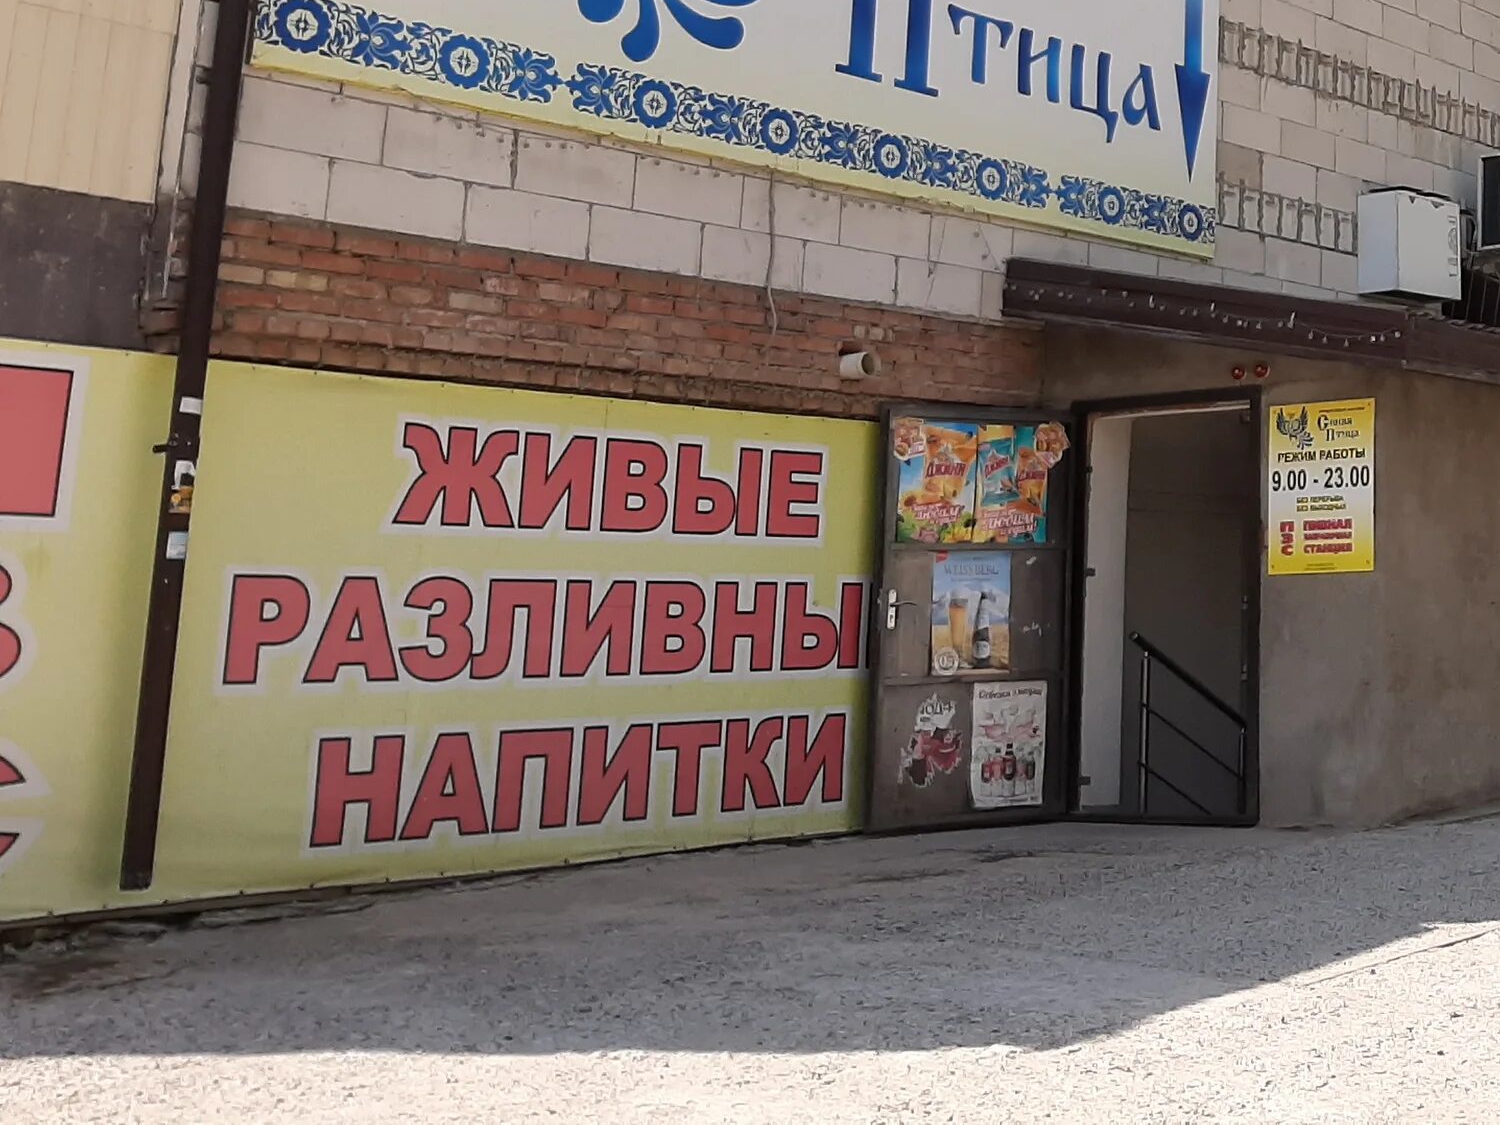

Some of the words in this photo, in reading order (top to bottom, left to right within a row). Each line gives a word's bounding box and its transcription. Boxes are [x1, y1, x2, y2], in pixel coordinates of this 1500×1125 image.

[392, 421, 825, 539] ЖИВЫЕ
[1271, 469, 1307, 492] 9.00
[1324, 465, 1370, 489] 23.00
[1277, 450, 1317, 463] РЕЖИМ
[1320, 447, 1366, 461] РАБОТЫ
[222, 573, 873, 684] РАЗЛИВНЫ
[309, 712, 848, 849] НАПИТКИ
